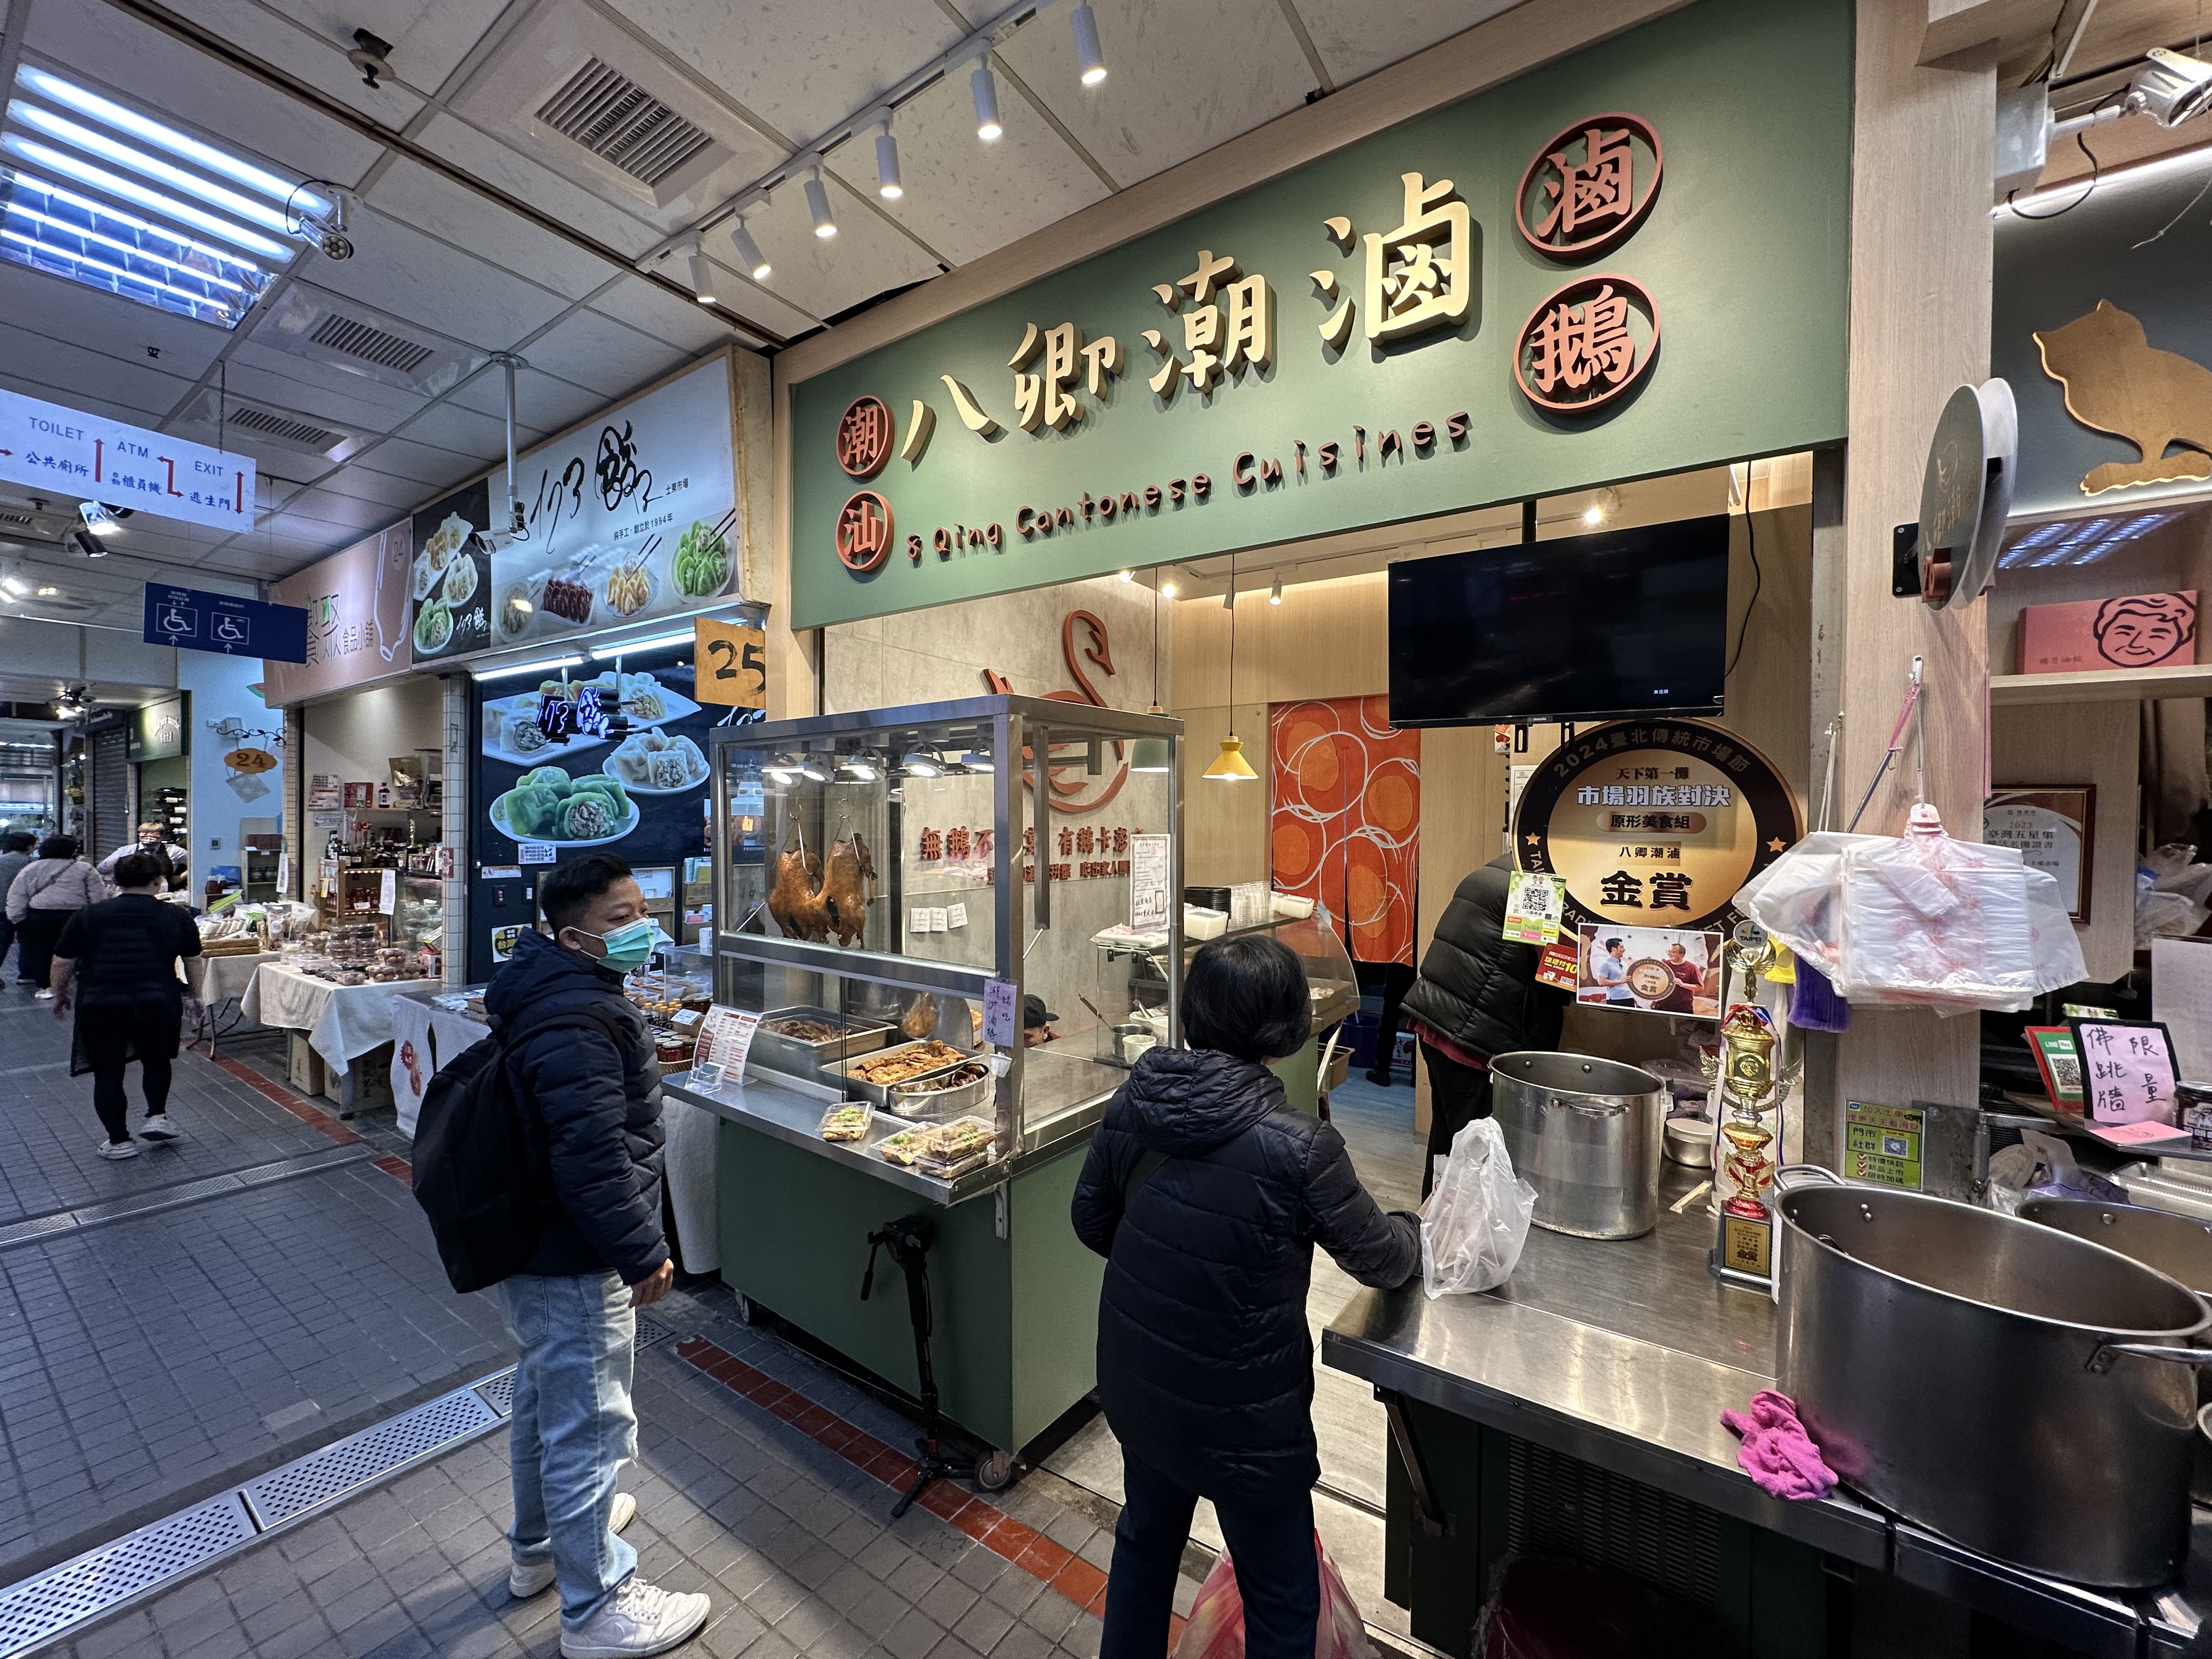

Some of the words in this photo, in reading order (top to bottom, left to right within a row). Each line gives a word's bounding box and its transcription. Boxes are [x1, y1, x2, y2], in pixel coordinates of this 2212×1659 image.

[900, 172, 1474, 463] 八卿潮滷
[29, 416, 84, 441] TOILET
[117, 441, 149, 459] ATM
[25, 450, 89, 477] 公共廁所
[195, 460, 224, 477] EXIT
[907, 533, 922, 560] 8
[933, 523, 1003, 554] Qing
[1015, 473, 1212, 535] Cantonese
[1232, 411, 1471, 485] Cuisines
[189, 490, 230, 511] 逃生門
[708, 640, 765, 696] 25
[236, 752, 266, 768] 24
[1615, 767, 1689, 780] 天下第一攤
[1577, 785, 1731, 807] 市場羽族對決
[1610, 814, 1691, 829] 原形美食組
[1619, 846, 1680, 860] 八卿潮滷
[1600, 870, 1694, 912] 金賞
[2129, 1036, 2167, 1104] 限量
[1853, 1126, 1876, 1138] 門市
[1853, 1139, 1876, 1151] 社群
[1868, 1164, 1904, 1176] 新品上市
